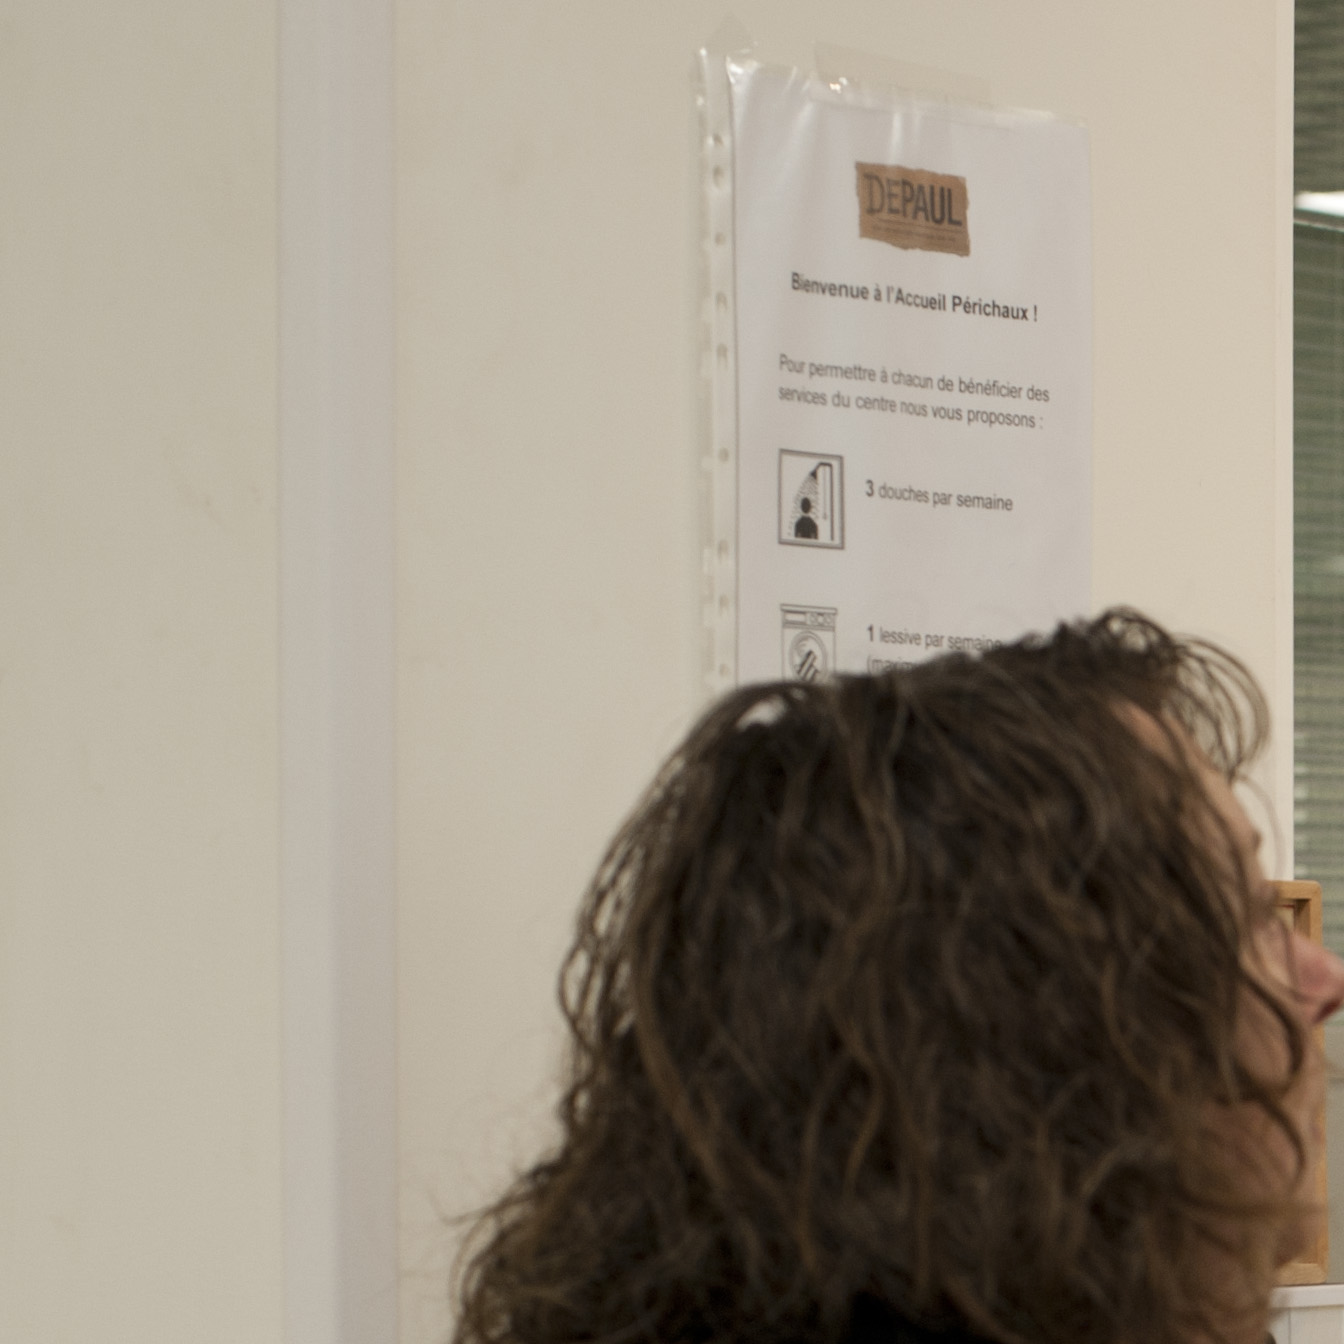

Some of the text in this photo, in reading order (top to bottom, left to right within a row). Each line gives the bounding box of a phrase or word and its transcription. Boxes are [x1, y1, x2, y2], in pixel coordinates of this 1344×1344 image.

[863, 173, 962, 226] DEPAUL
[791, 272, 869, 300] Bienvenue
[873, 284, 882, 302] à
[886, 287, 947, 312] l'Accueil
[951, 294, 1029, 321] Périchaux
[779, 353, 1050, 402] Pour permettre à chacun de bénéficier des
[779, 386, 827, 406] services
[832, 390, 850, 408] du
[855, 395, 897, 413] centre
[900, 400, 928, 417] nous
[931, 405, 963, 421] vous
[967, 408, 1036, 428] proposons
[865, 479, 1013, 511] 3 douches par semaine
[867, 624, 874, 642] 1
[879, 627, 921, 646] lessive
[925, 633, 944, 650] par
